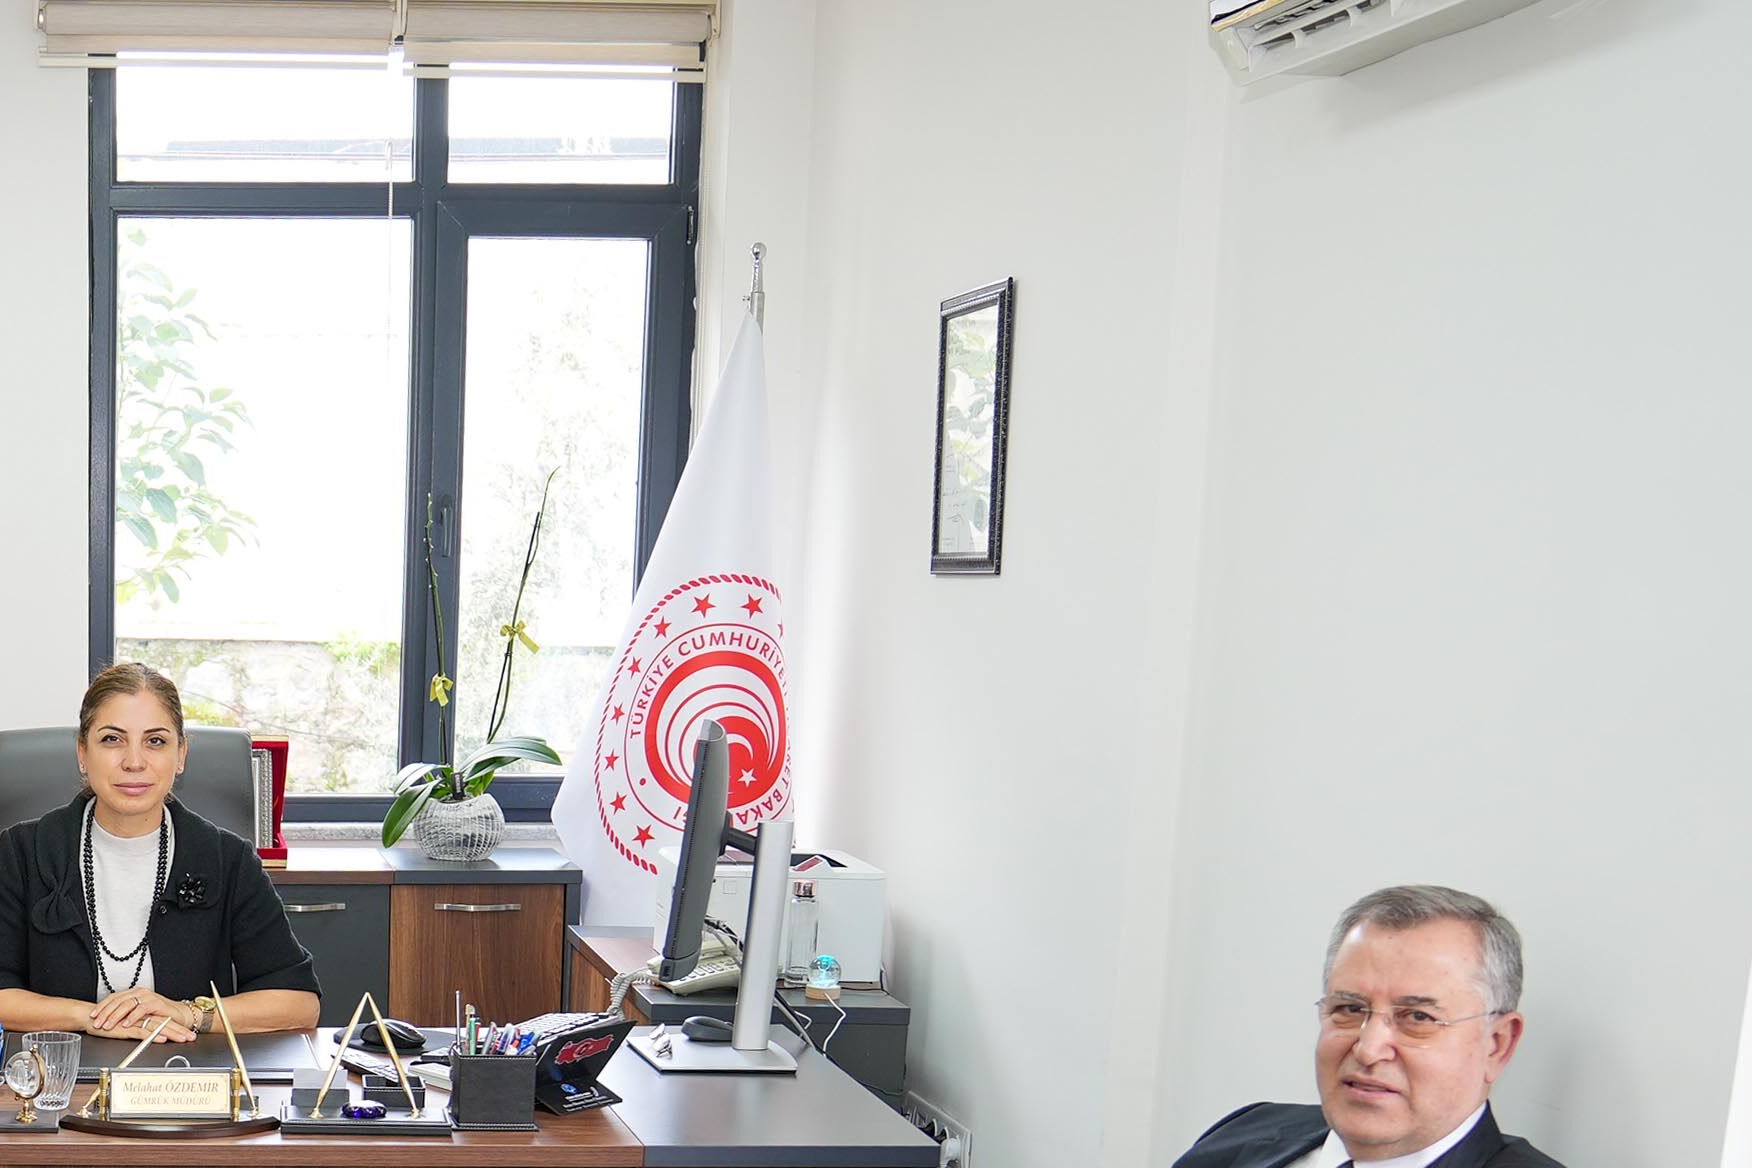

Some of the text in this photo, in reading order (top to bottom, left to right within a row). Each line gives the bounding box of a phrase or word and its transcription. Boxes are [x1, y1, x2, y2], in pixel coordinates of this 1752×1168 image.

[630, 631, 788, 739] TÜRKİYE CUMHURİYE
[123, 1079, 219, 1093] Melahat ÖZDEMİR
[130, 1095, 169, 1105] GÜMRÜK
